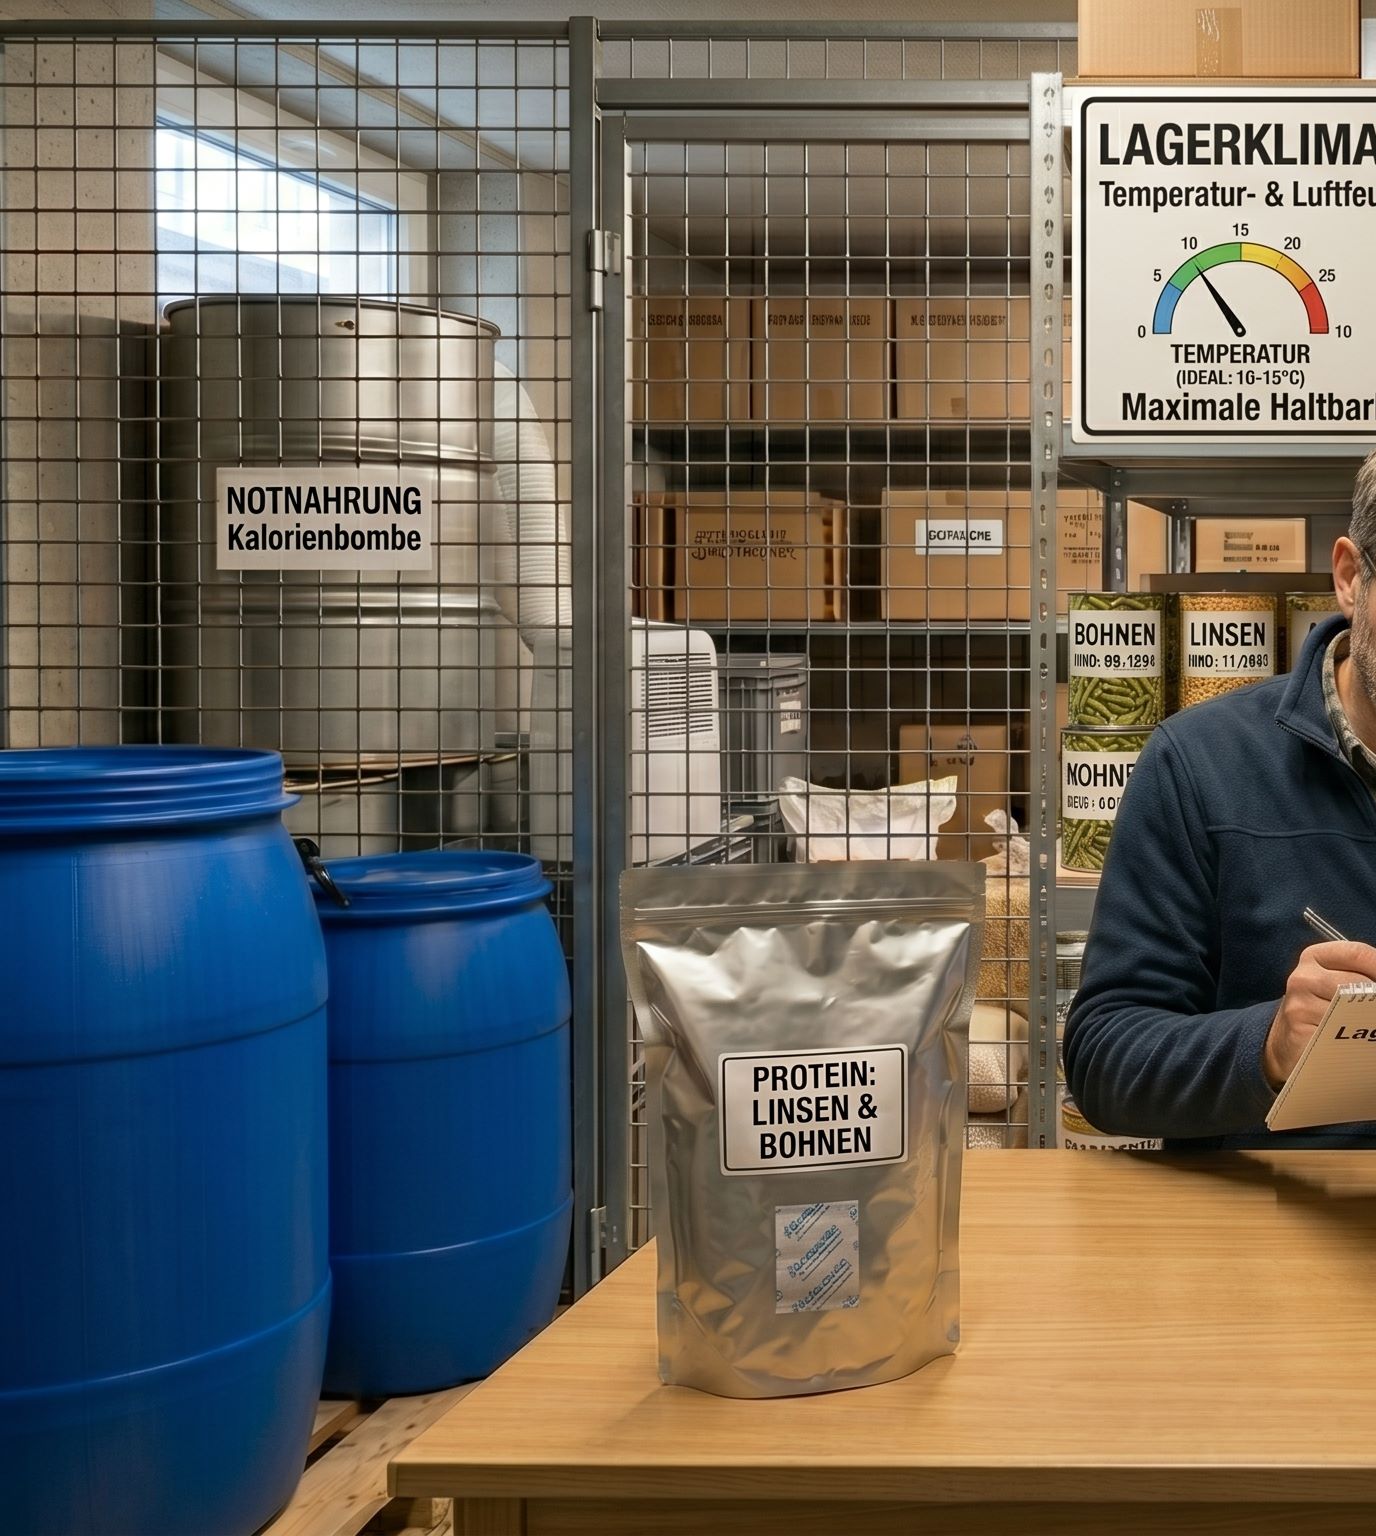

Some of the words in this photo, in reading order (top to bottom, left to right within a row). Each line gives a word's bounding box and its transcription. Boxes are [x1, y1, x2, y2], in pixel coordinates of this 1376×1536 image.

[1100, 181, 1256, 213] Temperatur-
[1265, 183, 1284, 207] &
[1232, 224, 1249, 237] 15
[1181, 236, 1197, 250] 10
[1284, 236, 1300, 250] 20
[1153, 269, 1161, 282] 5
[1319, 269, 1336, 282] 25
[1137, 325, 1146, 339] 0
[1336, 325, 1352, 339] 10
[1171, 344, 1310, 364] TEMPERATUR
[1176, 370, 1232, 388] (IDEAL:
[1122, 392, 1260, 422] Maximale
[228, 486, 421, 514] NOTNAHRUNG
[228, 523, 421, 550] Kalorienbombe
[1075, 623, 1155, 646] BOHNEN
[1191, 622, 1265, 646] LINSEN
[754, 1060, 876, 1092] PROTEIN:
[754, 1094, 848, 1126] LINSEN
[858, 1093, 878, 1119] &
[760, 1126, 871, 1160] BOHNEN
